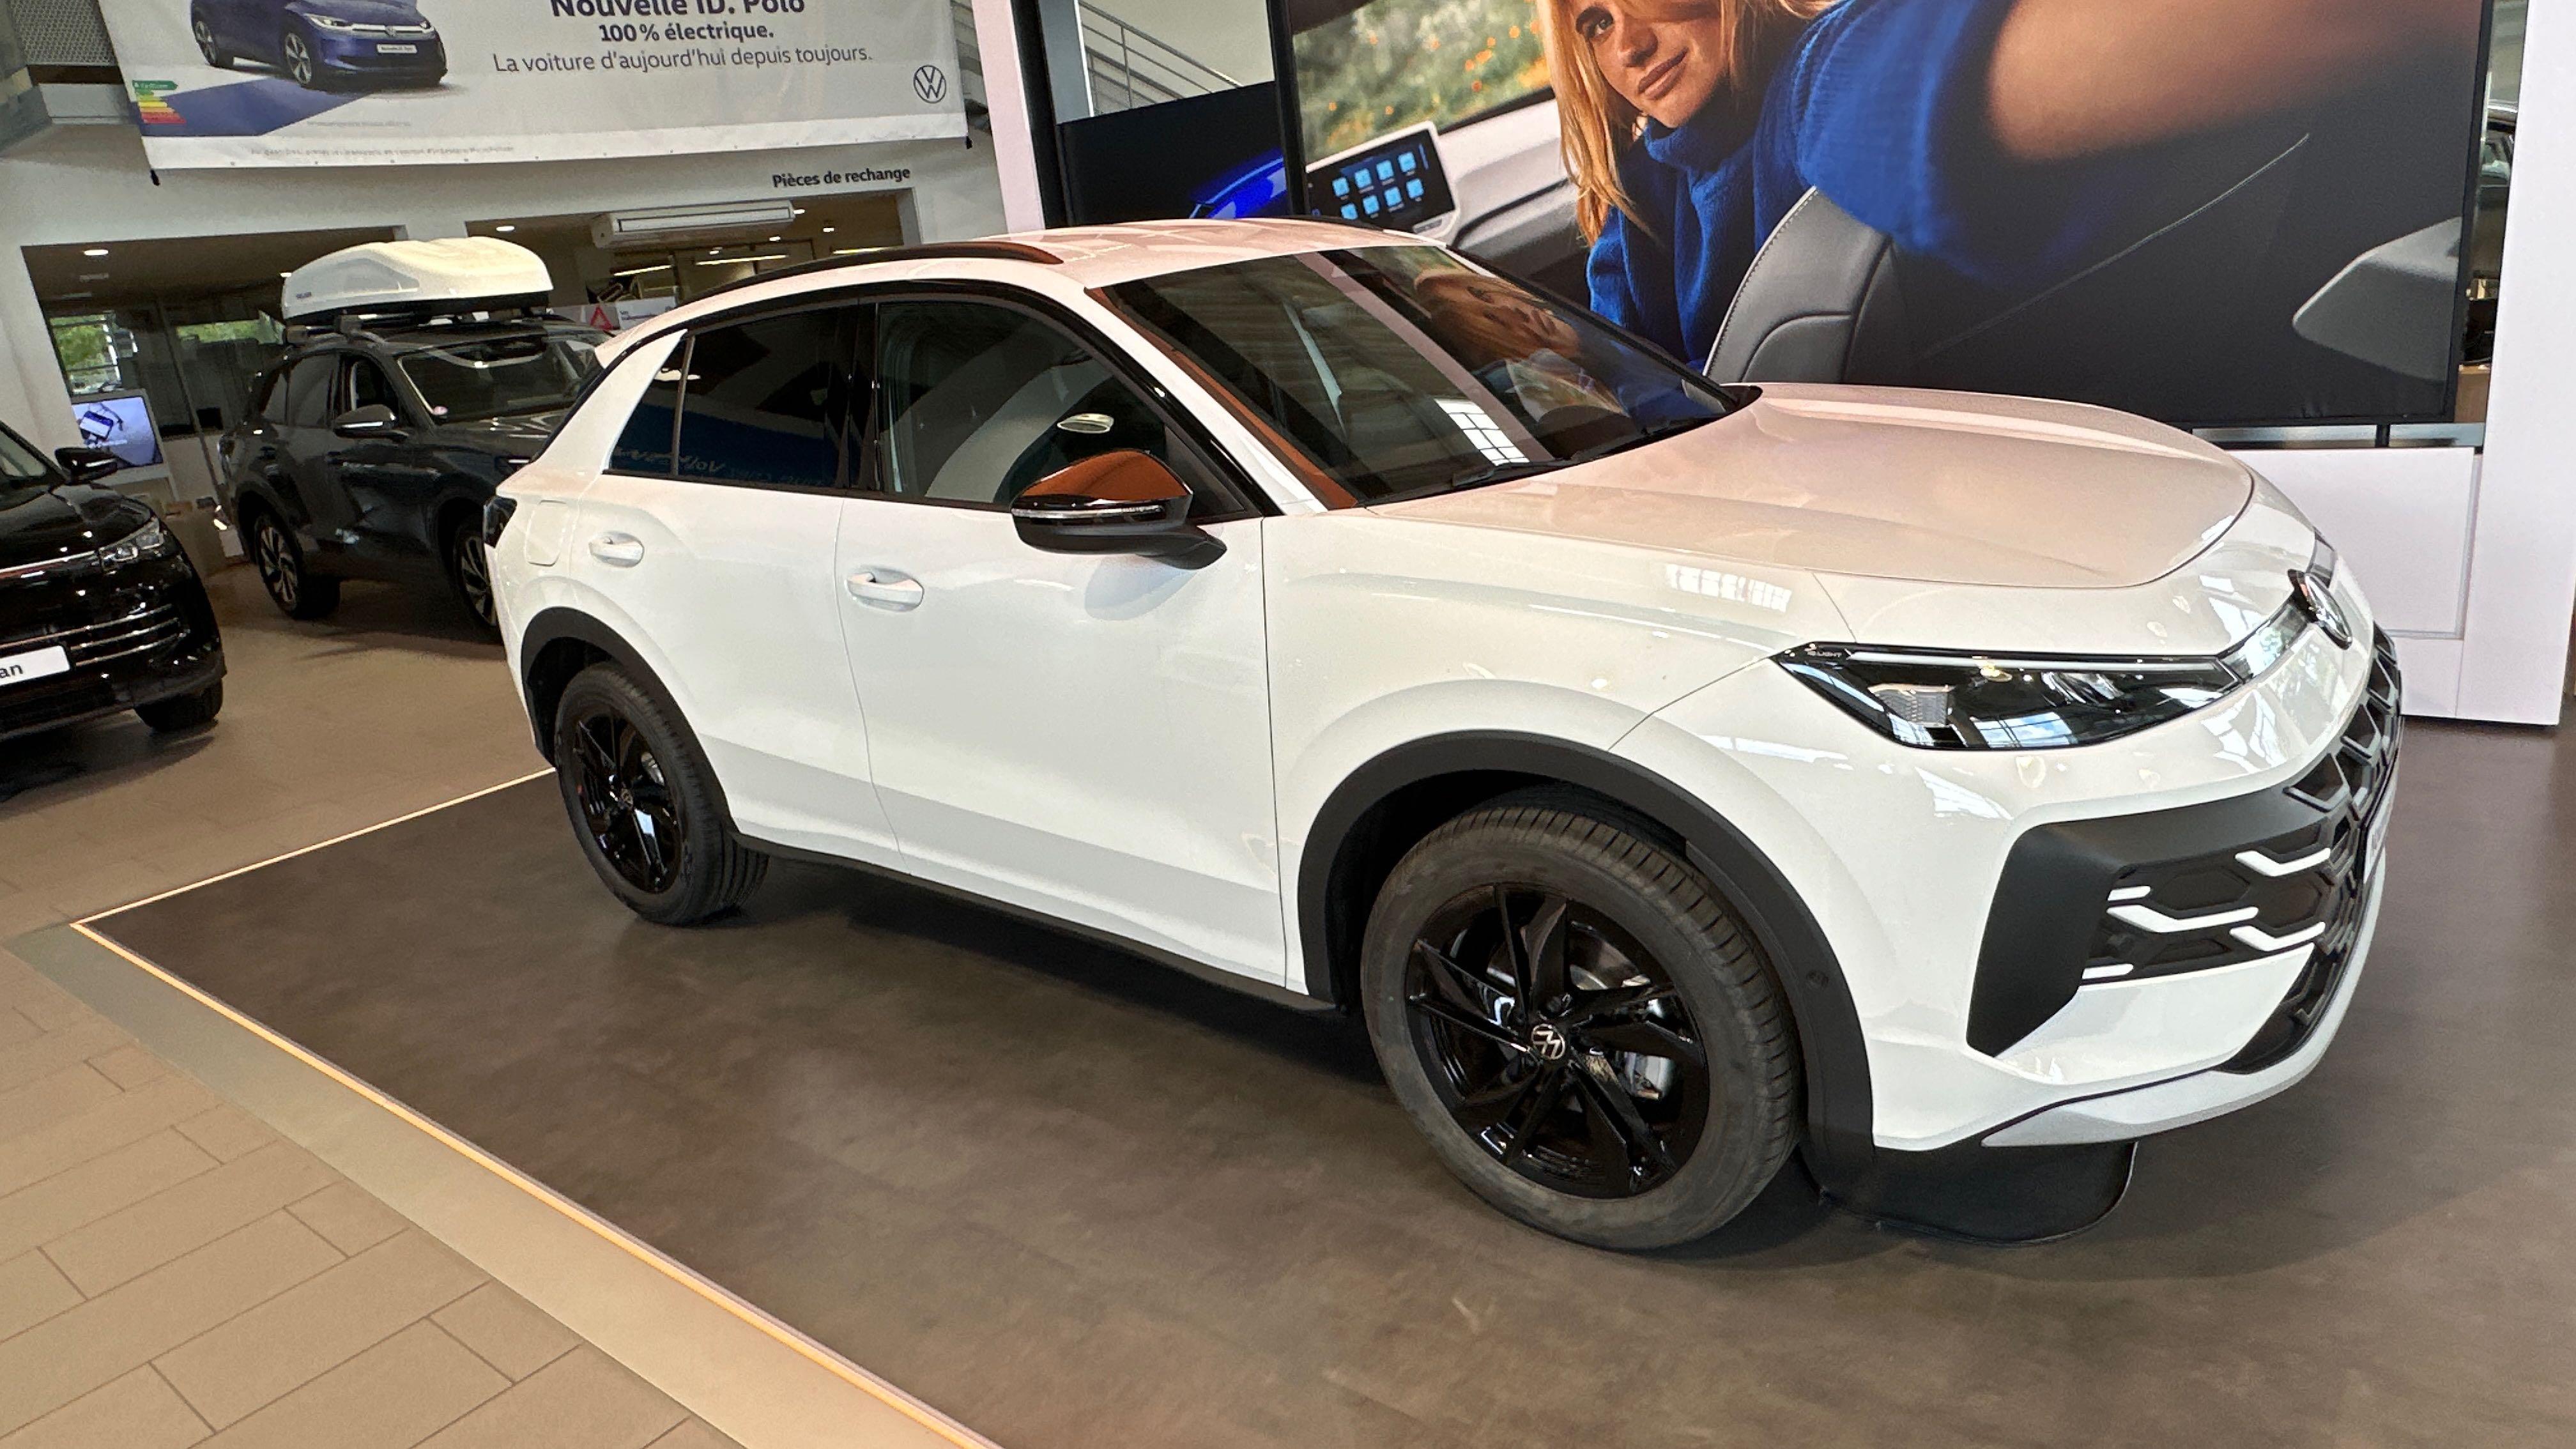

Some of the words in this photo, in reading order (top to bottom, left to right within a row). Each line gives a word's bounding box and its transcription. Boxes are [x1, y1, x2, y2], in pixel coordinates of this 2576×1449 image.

[551, 0, 687, 16] Nouvelle
[696, 0, 735, 14] ID.
[744, 0, 804, 13] Polo
[664, 20, 774, 43] électrique.
[493, 53, 519, 72] La
[522, 53, 595, 72] voiture
[601, 47, 726, 73] d'aujourd'hui
[731, 45, 791, 69] depuis
[795, 43, 873, 66] toujours.
[772, 172, 820, 188] Pièces
[824, 170, 842, 184] de
[845, 167, 911, 183] rechange
